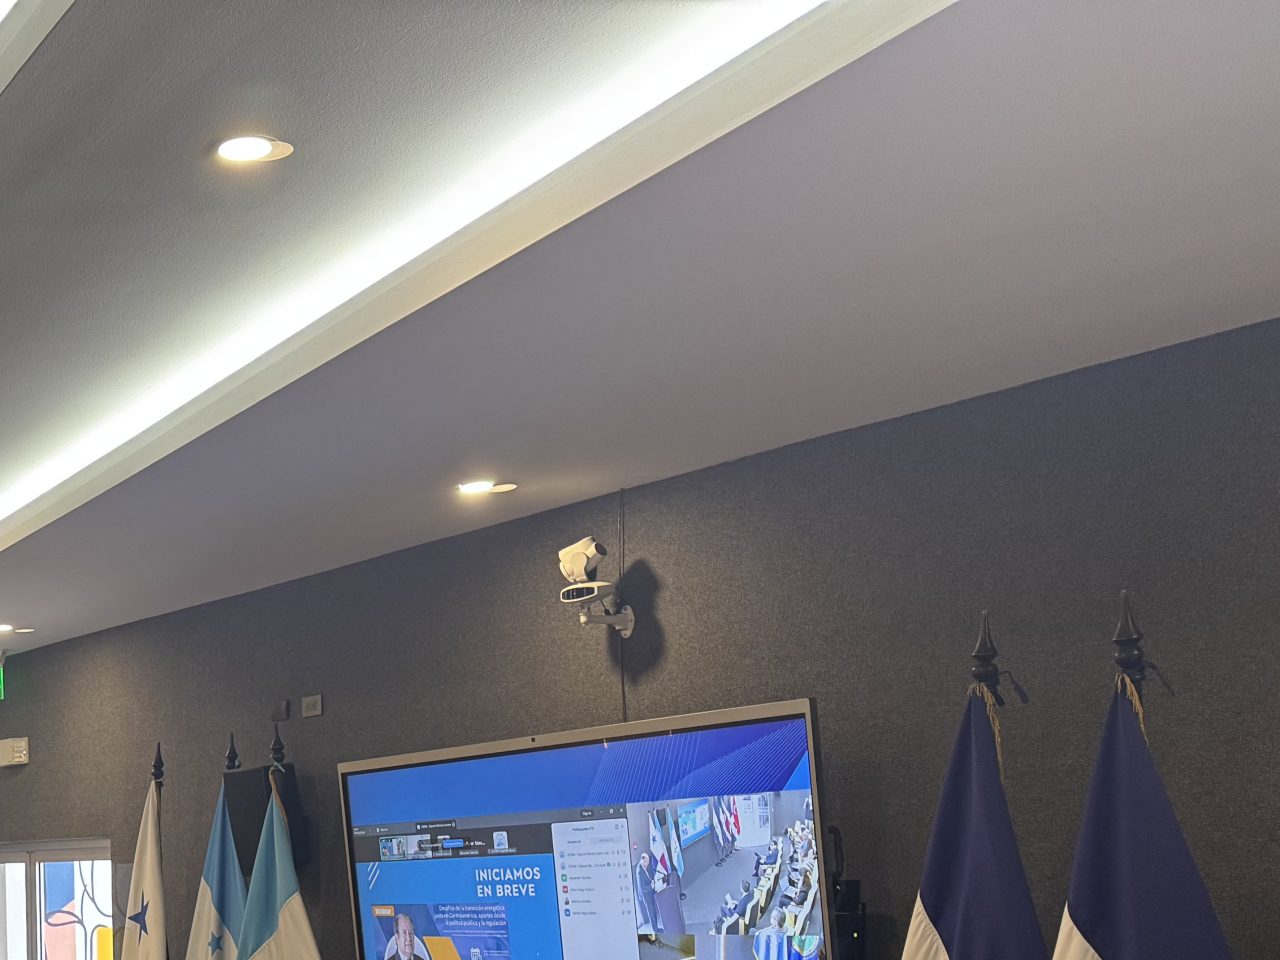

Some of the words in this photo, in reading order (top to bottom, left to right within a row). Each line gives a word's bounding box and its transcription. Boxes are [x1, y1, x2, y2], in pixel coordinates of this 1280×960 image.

[475, 866, 541, 881] INICIAMOS
[476, 884, 492, 897] EN
[496, 883, 536, 897] BREVE
